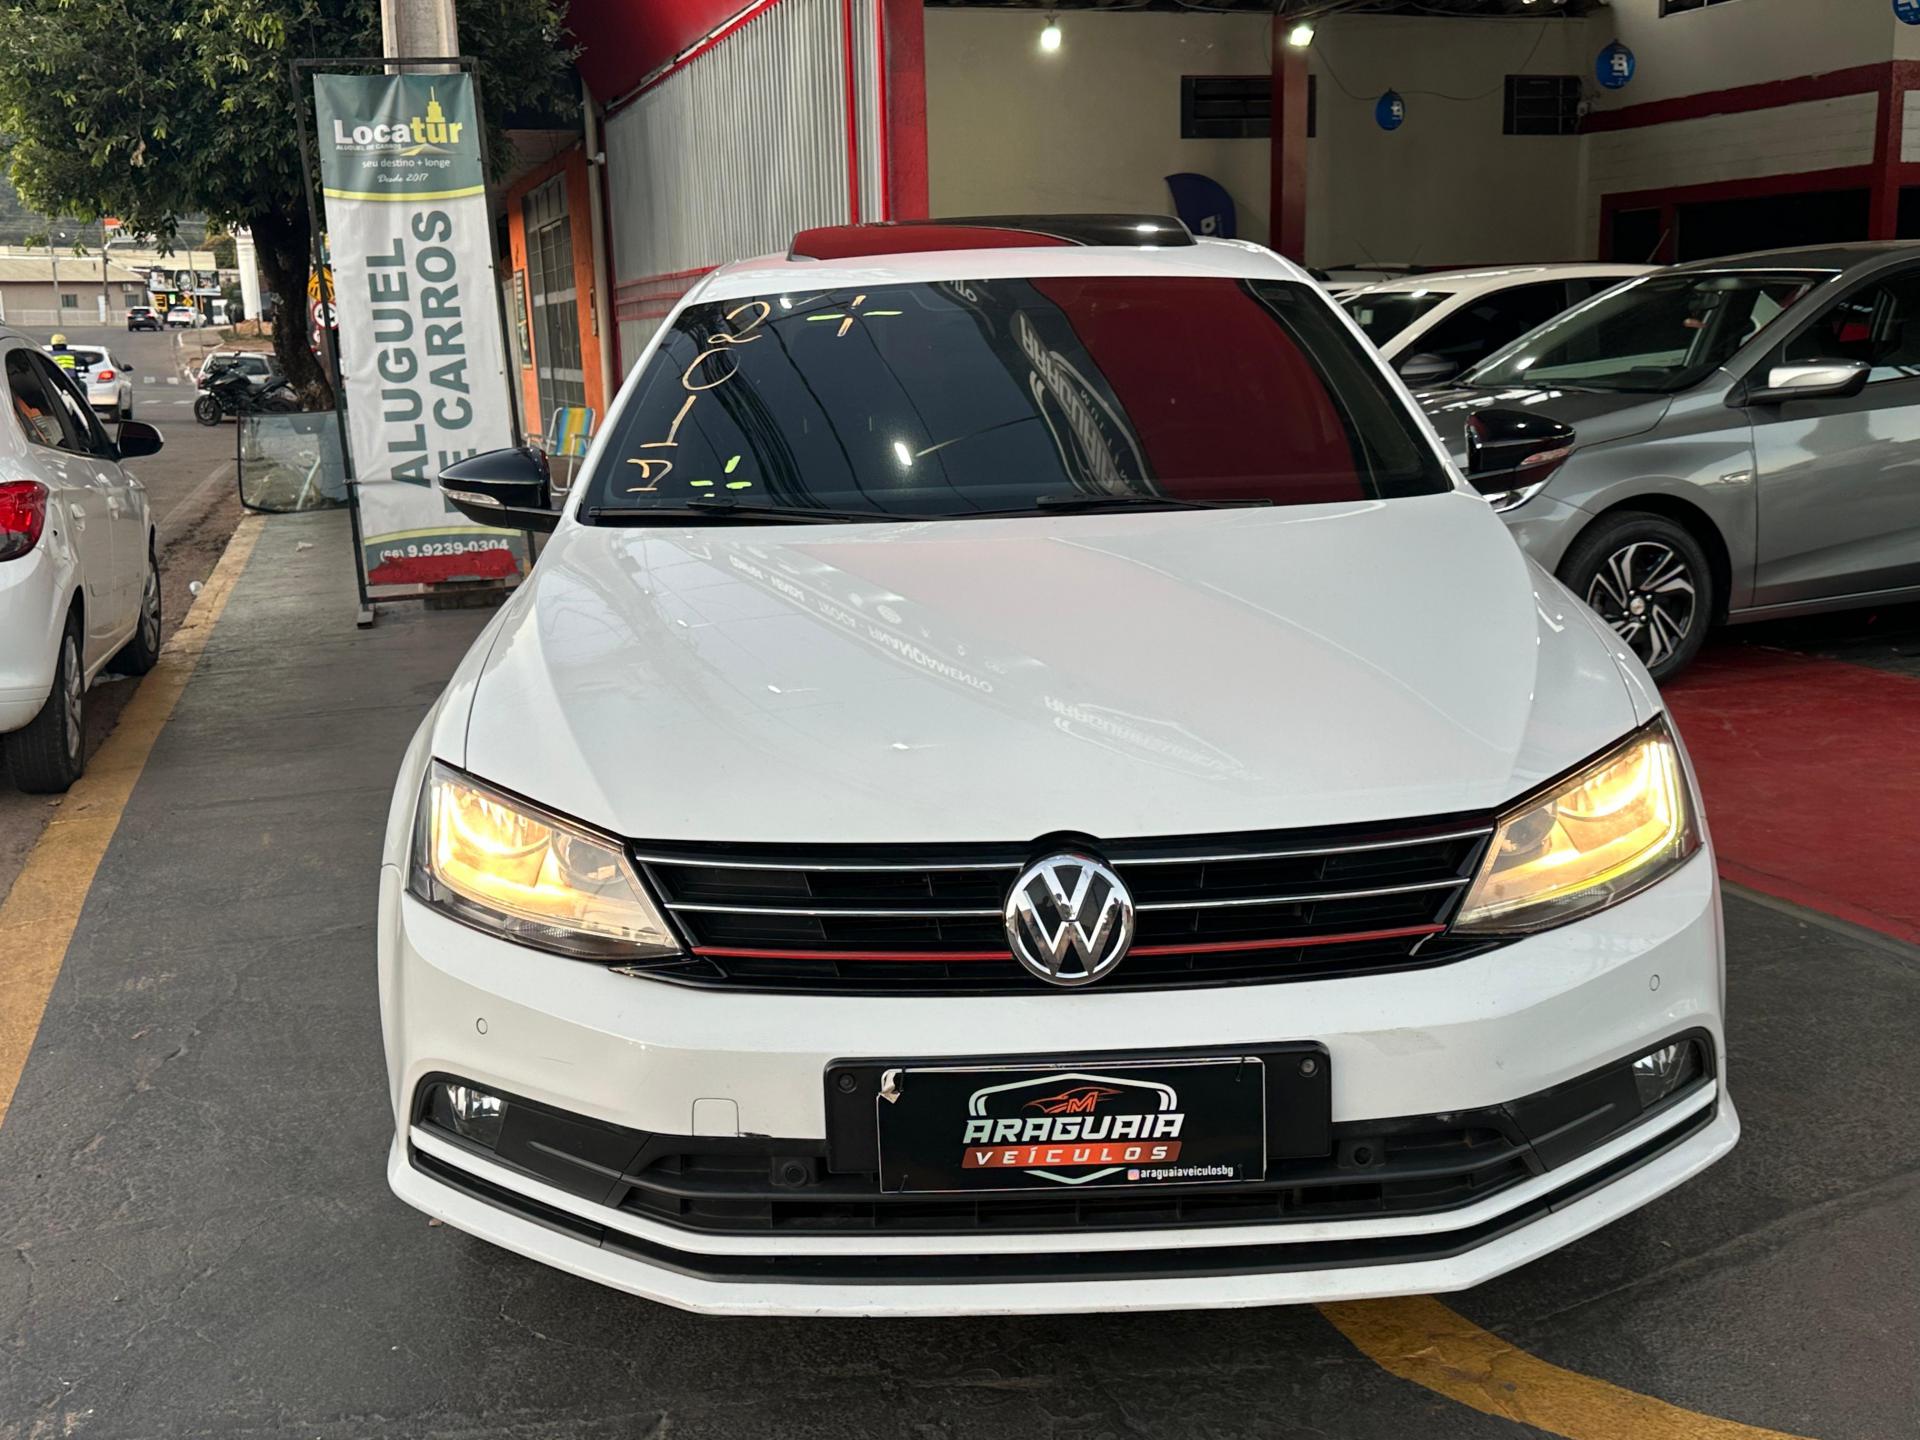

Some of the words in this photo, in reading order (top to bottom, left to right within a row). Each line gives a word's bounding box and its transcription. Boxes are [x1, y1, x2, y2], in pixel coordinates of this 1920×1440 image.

[334, 116, 463, 144] Locatur
[362, 160, 378, 168] seu
[380, 158, 415, 168] destino
[424, 158, 451, 169] longe
[405, 172, 429, 182] 2017
[411, 210, 473, 430] CARROS
[366, 238, 432, 488] ALUGUEL
[962, 1113, 1185, 1144] ARAGUAIA
[975, 1146, 1168, 1166] VEÍCULOS
[1140, 1164, 1234, 1179] araguaiaveiculosbg
